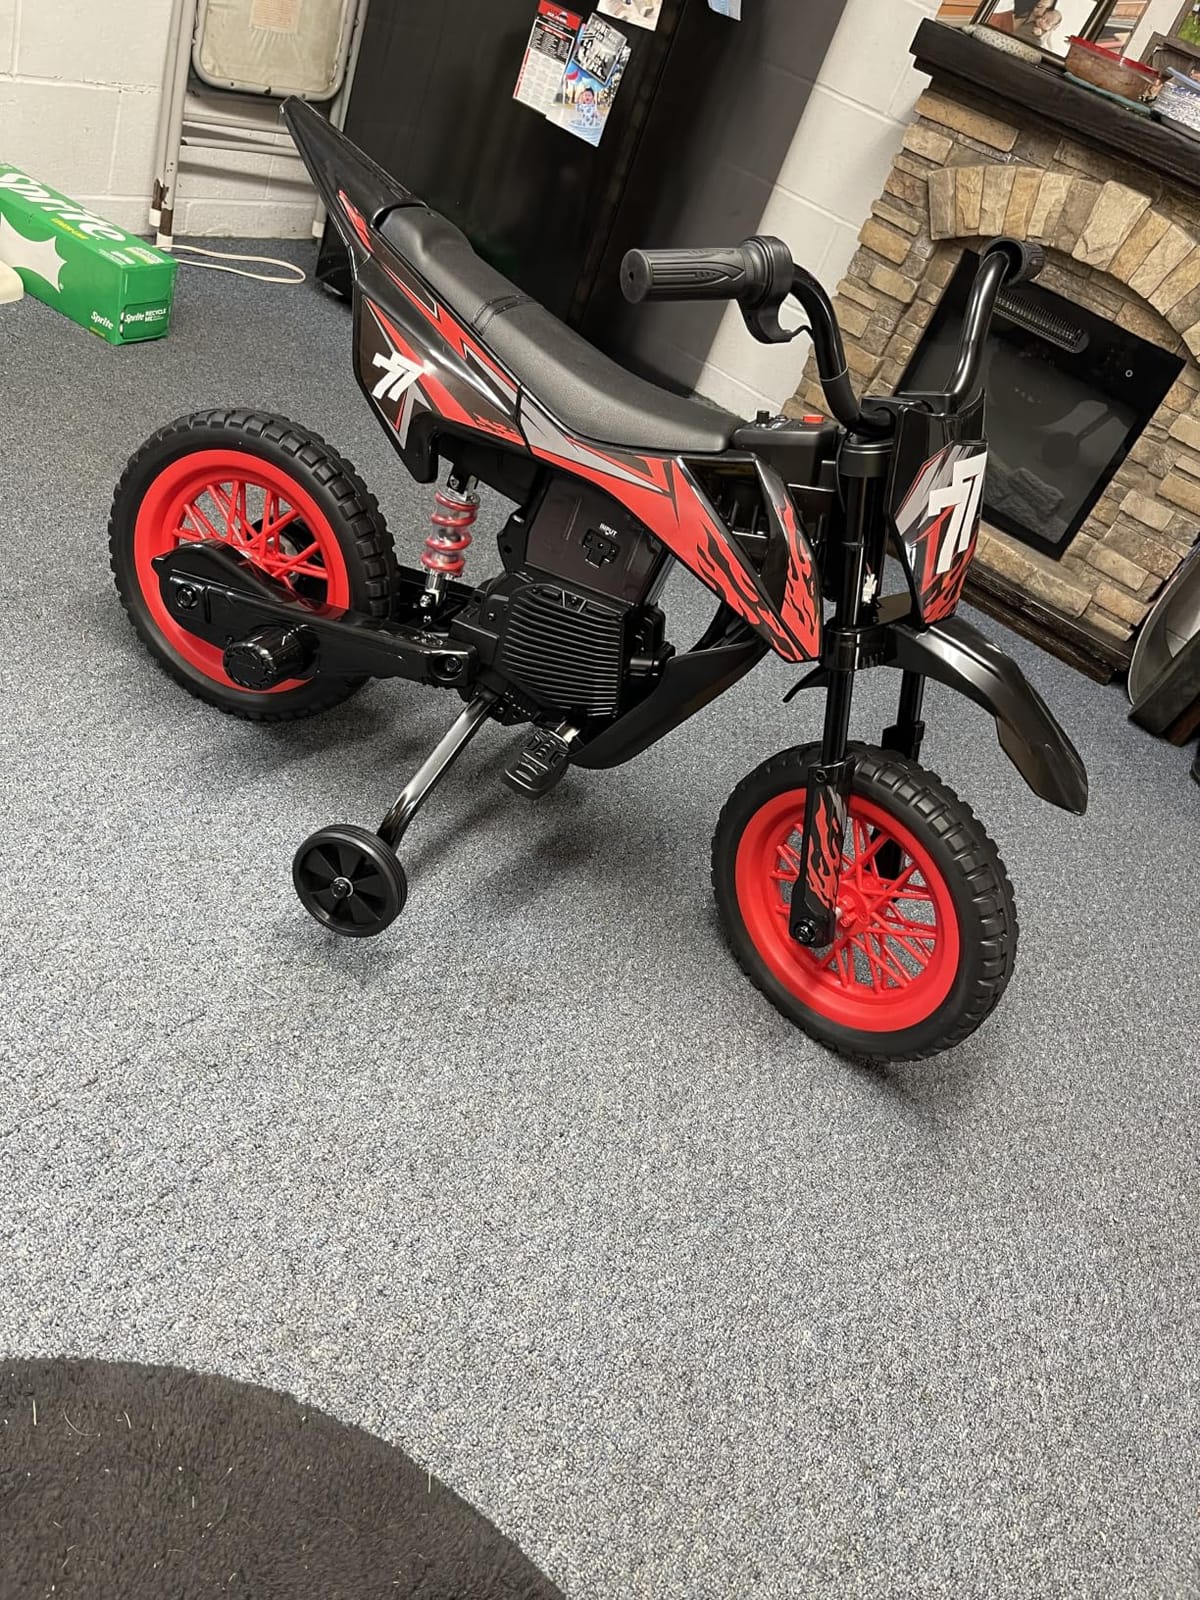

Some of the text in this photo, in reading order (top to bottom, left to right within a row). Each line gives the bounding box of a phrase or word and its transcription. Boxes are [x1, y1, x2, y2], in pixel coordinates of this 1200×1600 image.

[91, 311, 114, 330] Sprite
[125, 313, 145, 324] Sprite
[372, 352, 425, 402] 77
[928, 452, 988, 574] 77
[599, 523, 618, 537] INPUT
